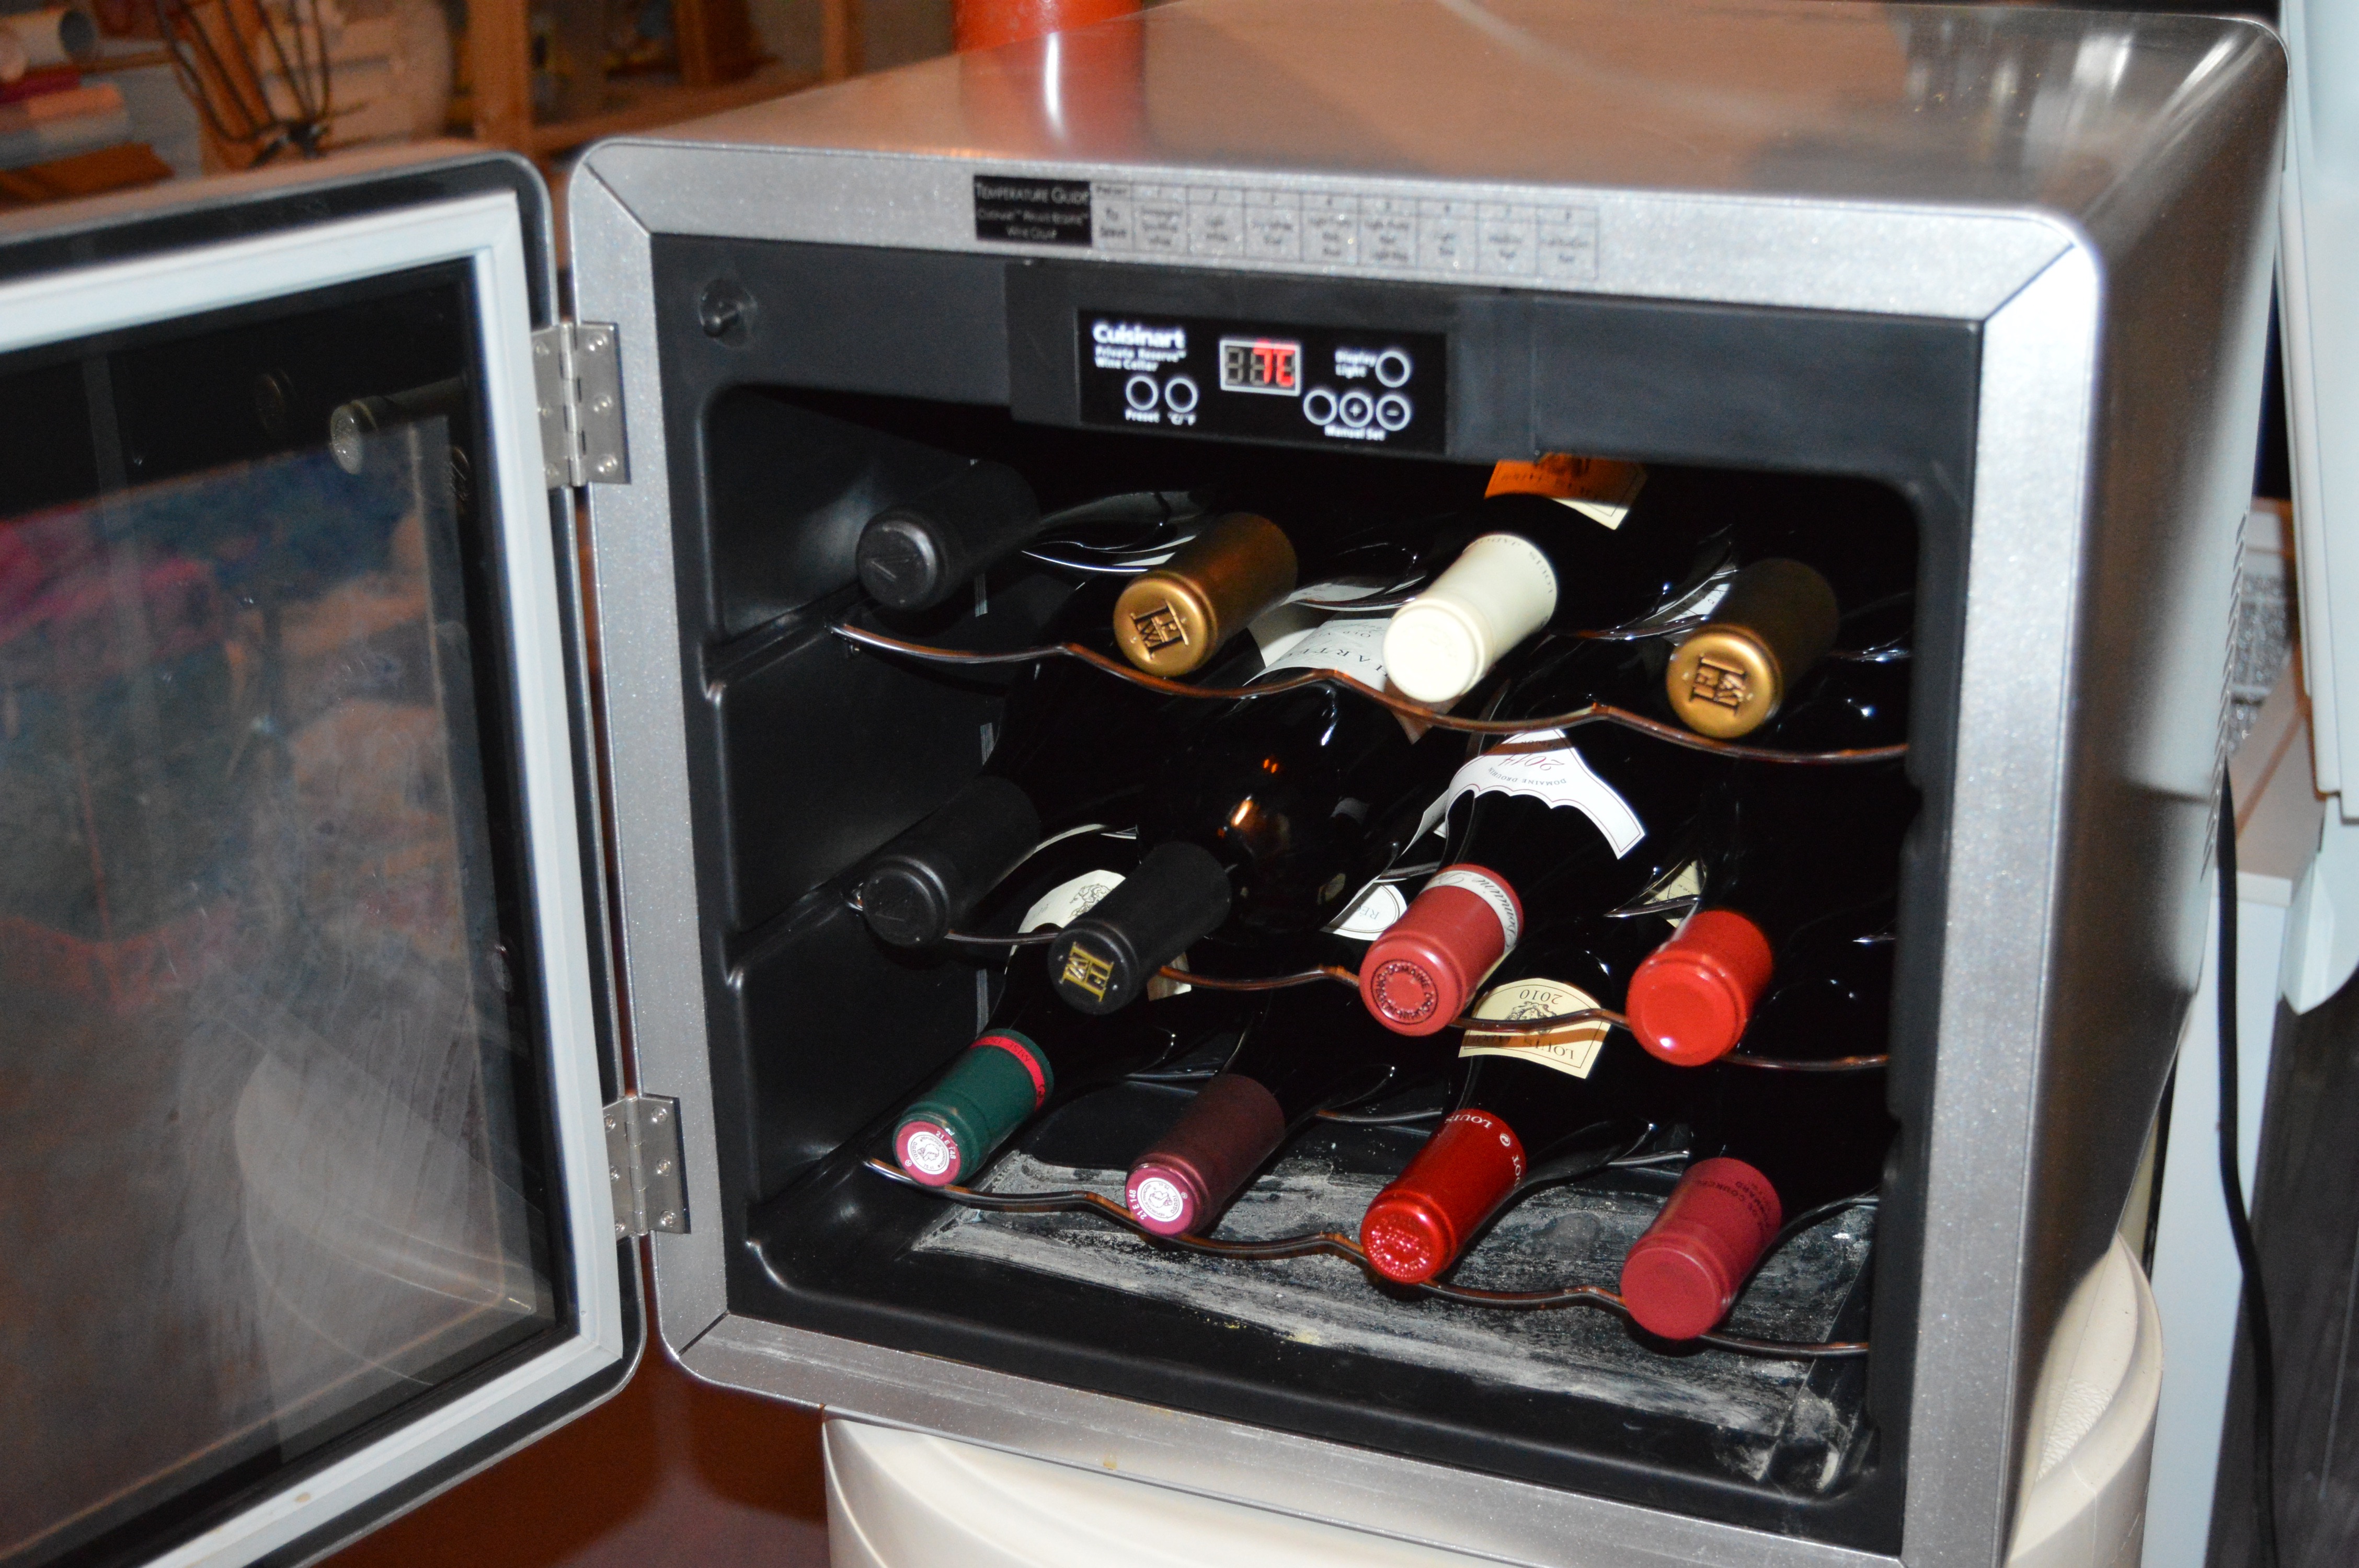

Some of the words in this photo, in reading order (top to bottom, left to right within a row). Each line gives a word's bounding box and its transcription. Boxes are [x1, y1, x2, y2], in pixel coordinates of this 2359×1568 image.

[1093, 323, 1186, 350] Cuisinart
[1125, 409, 1160, 423] Preset
[1324, 424, 1366, 440] Manual
[1365, 427, 1386, 442] Set
[1488, 767, 1519, 783] DROUHIN
[1521, 778, 1567, 787] DOMAINE
[1519, 989, 1563, 1005] 2010
[1445, 1114, 1493, 1129] LOUIS
[935, 1131, 945, 1139] 21
[948, 1146, 957, 1159] 148
[1128, 1189, 1138, 1203] 148
[1136, 1209, 1148, 1220] 21
